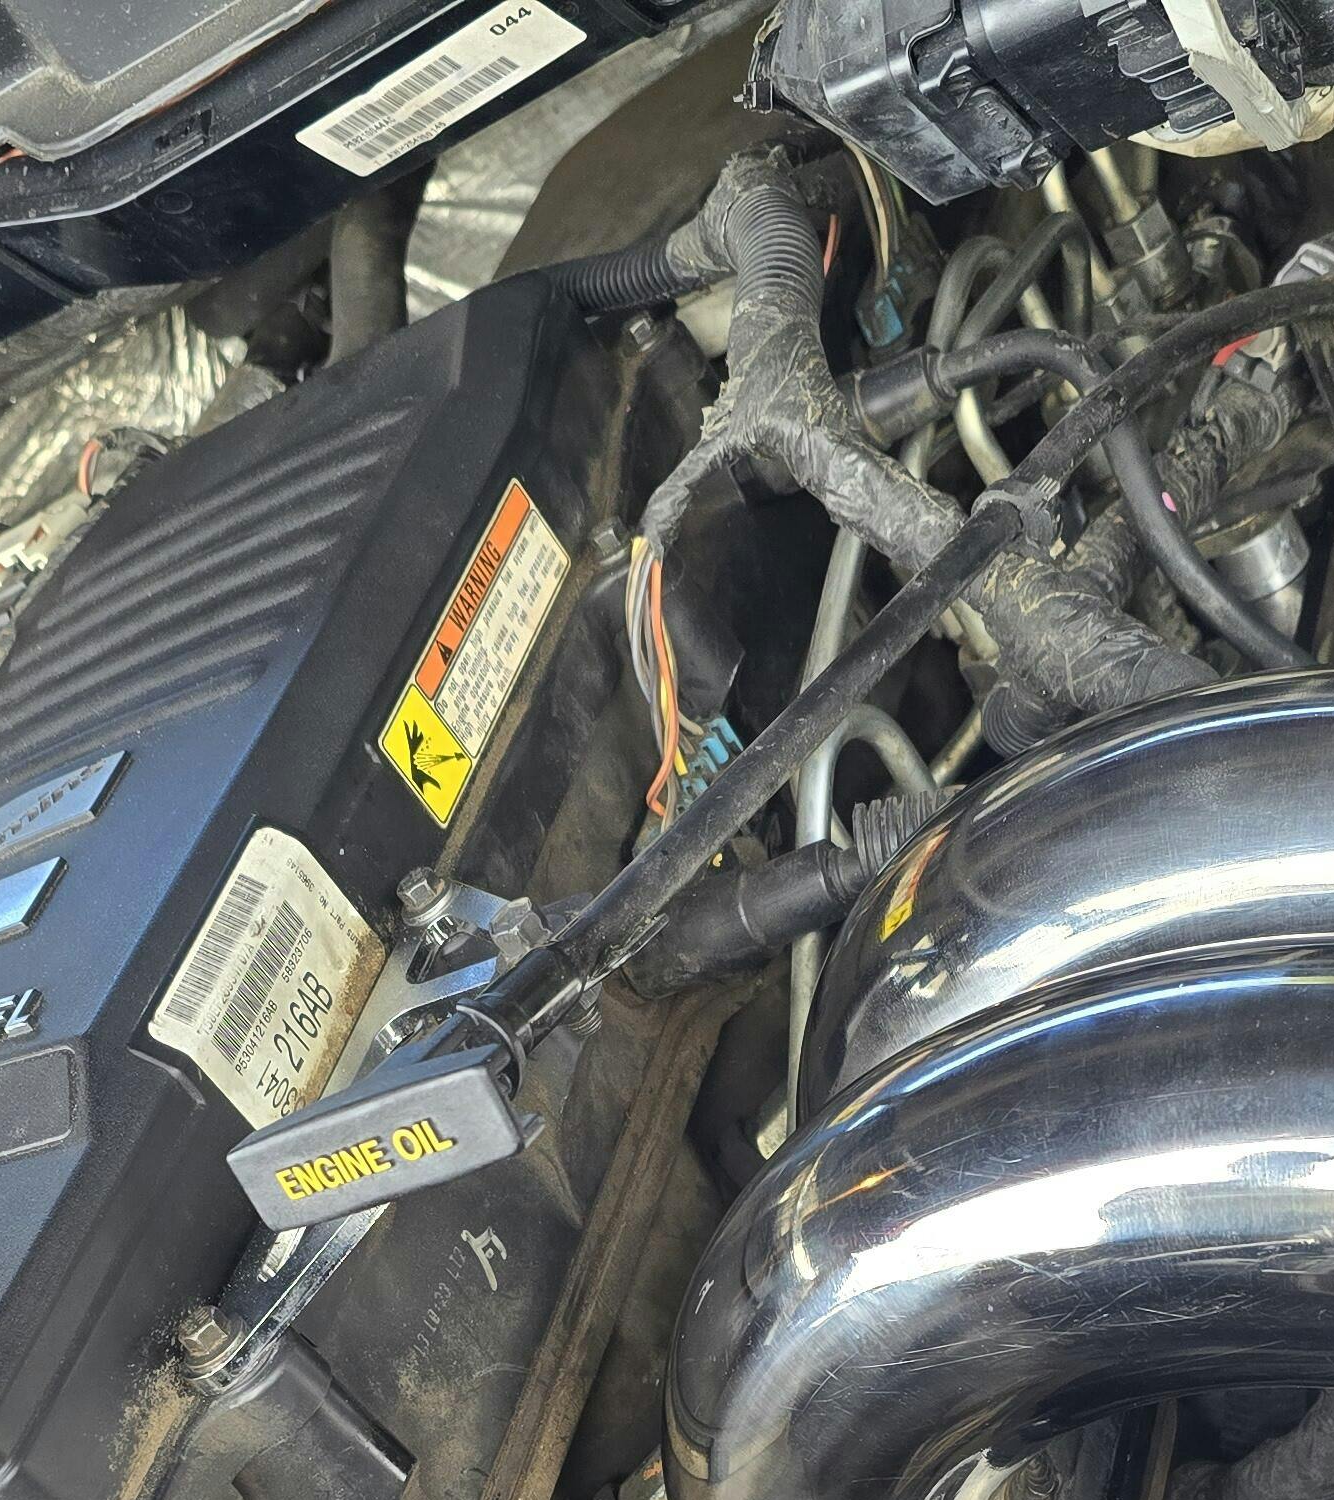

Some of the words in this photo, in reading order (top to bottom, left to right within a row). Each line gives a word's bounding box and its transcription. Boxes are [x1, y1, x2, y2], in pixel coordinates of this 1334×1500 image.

[489, 6, 532, 36] 044
[436, 699, 448, 714] Do
[448, 677, 458, 695] not
[458, 652, 471, 675] open
[469, 629, 483, 649] high
[483, 589, 502, 628] pressure
[500, 567, 513, 585] fuel
[513, 537, 528, 565] system
[448, 540, 501, 632] WARNING
[452, 703, 469, 734] Engine
[470, 657, 492, 699] operation
[492, 625, 508, 655] causes
[506, 602, 519, 622] high
[517, 579, 529, 599] fuel
[454, 679, 470, 709] engine
[459, 722, 473, 743] High
[473, 680, 493, 719] pressure
[491, 655, 504, 676] fuel
[504, 630, 519, 655] spray
[517, 610, 527, 626] can
[528, 582, 541, 606] cause
[490, 696, 497, 708] or
[329, 909, 346, 930] Part
[235, 1000, 278, 1076] P53041216AB
[281, 929, 312, 983] 58323706
[273, 971, 334, 1073] 216AB
[275, 1139, 391, 1200] ENGINE
[392, 1119, 455, 1161] OIL
